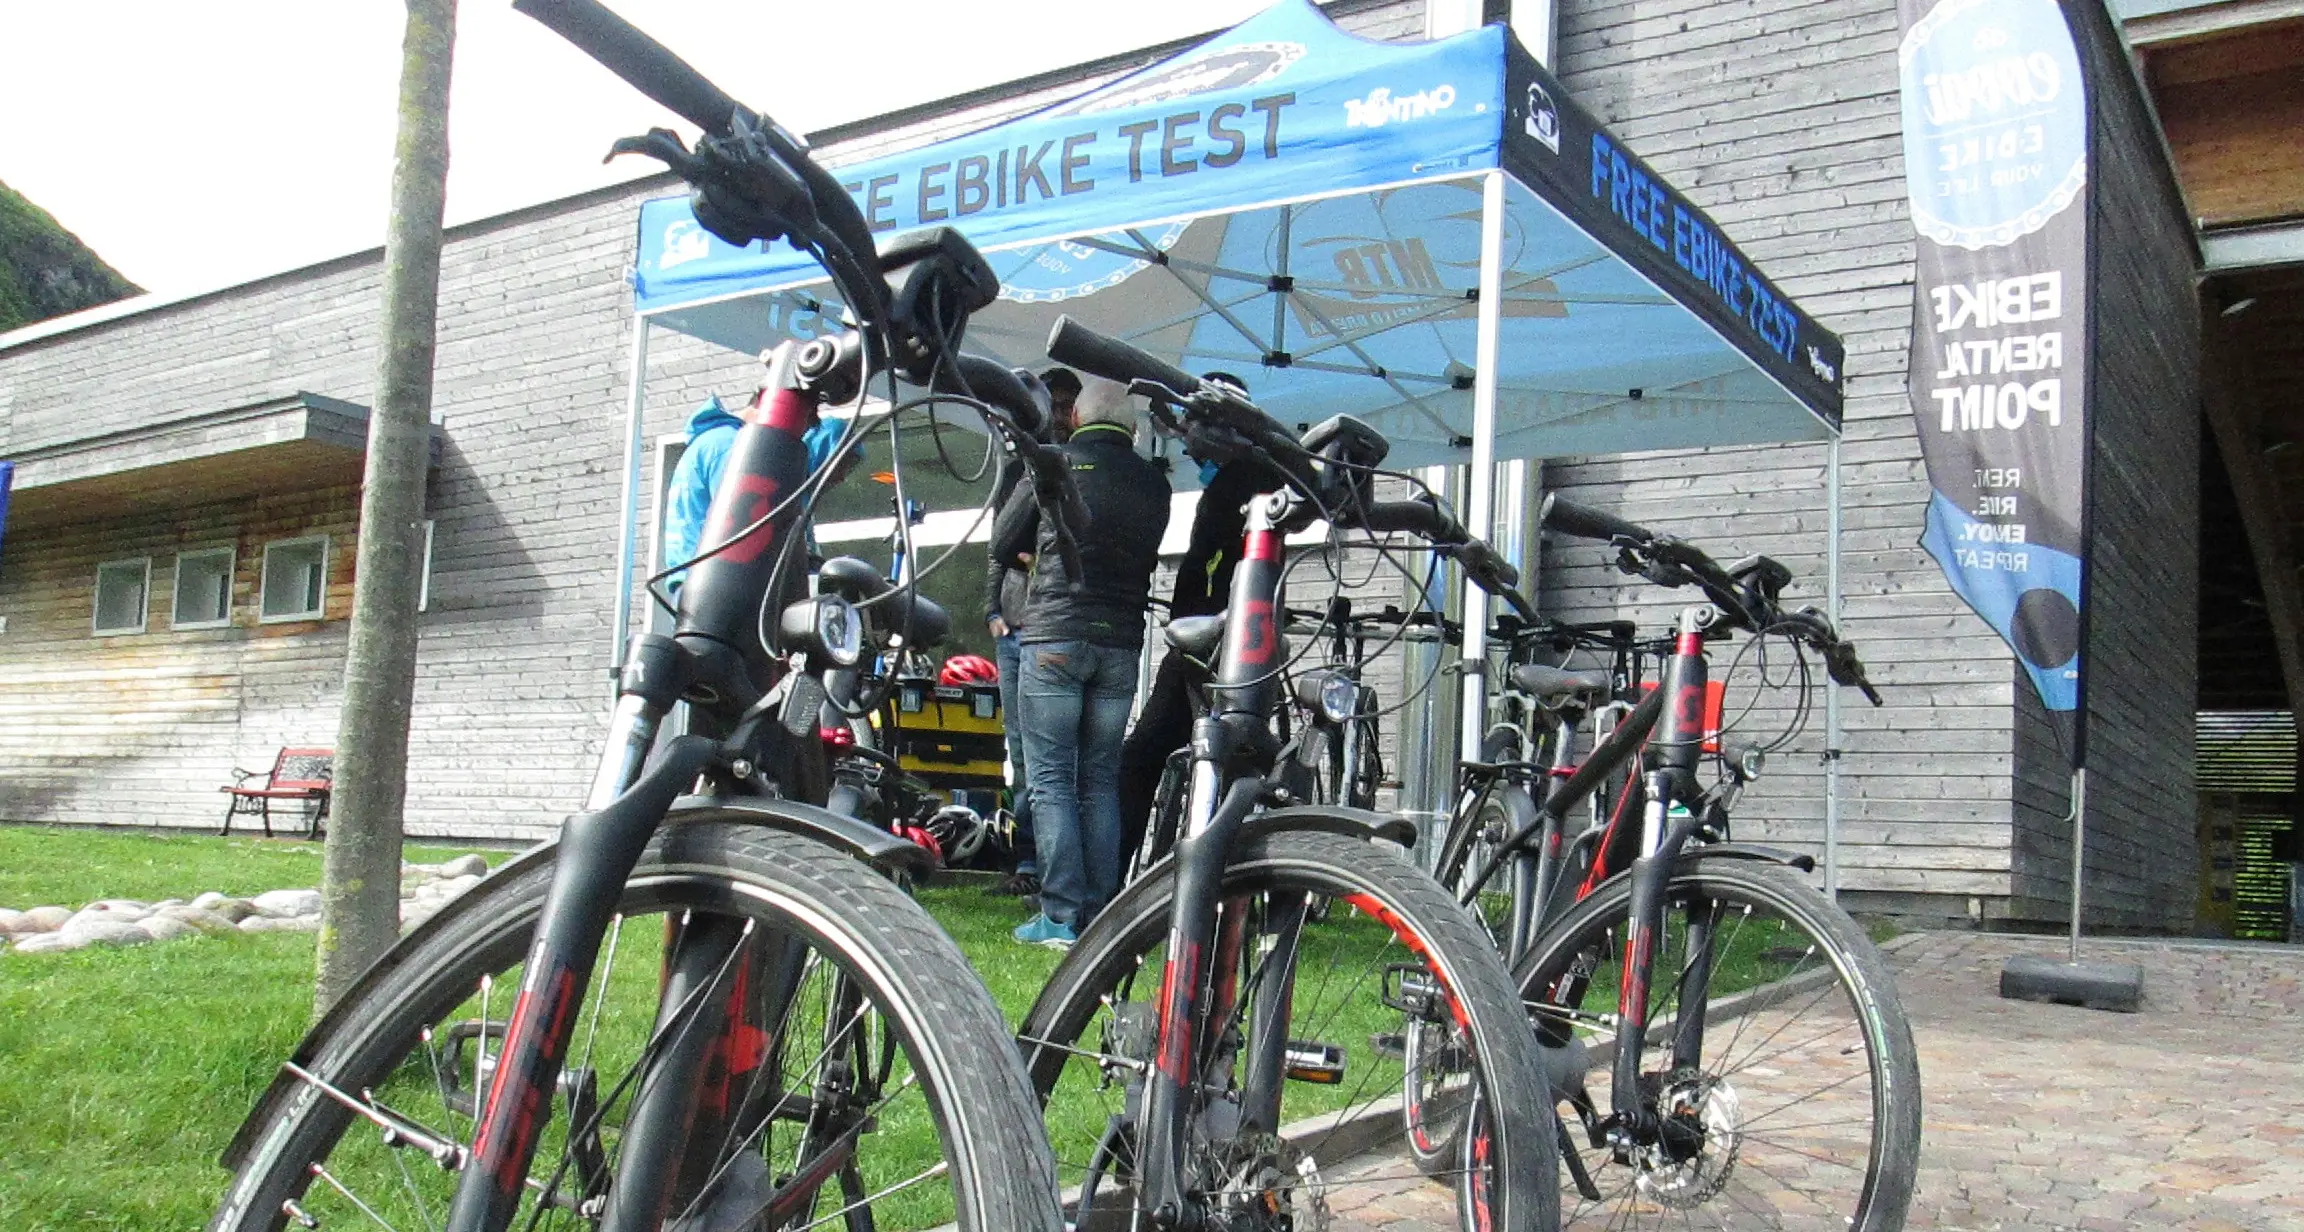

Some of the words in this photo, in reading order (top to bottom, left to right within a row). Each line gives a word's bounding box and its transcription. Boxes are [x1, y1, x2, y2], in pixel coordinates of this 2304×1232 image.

[918, 131, 1097, 224] EBIKE
[1118, 92, 1296, 184] TEST
[1591, 133, 1667, 251] FREE
[1674, 205, 1745, 317] EBIKE
